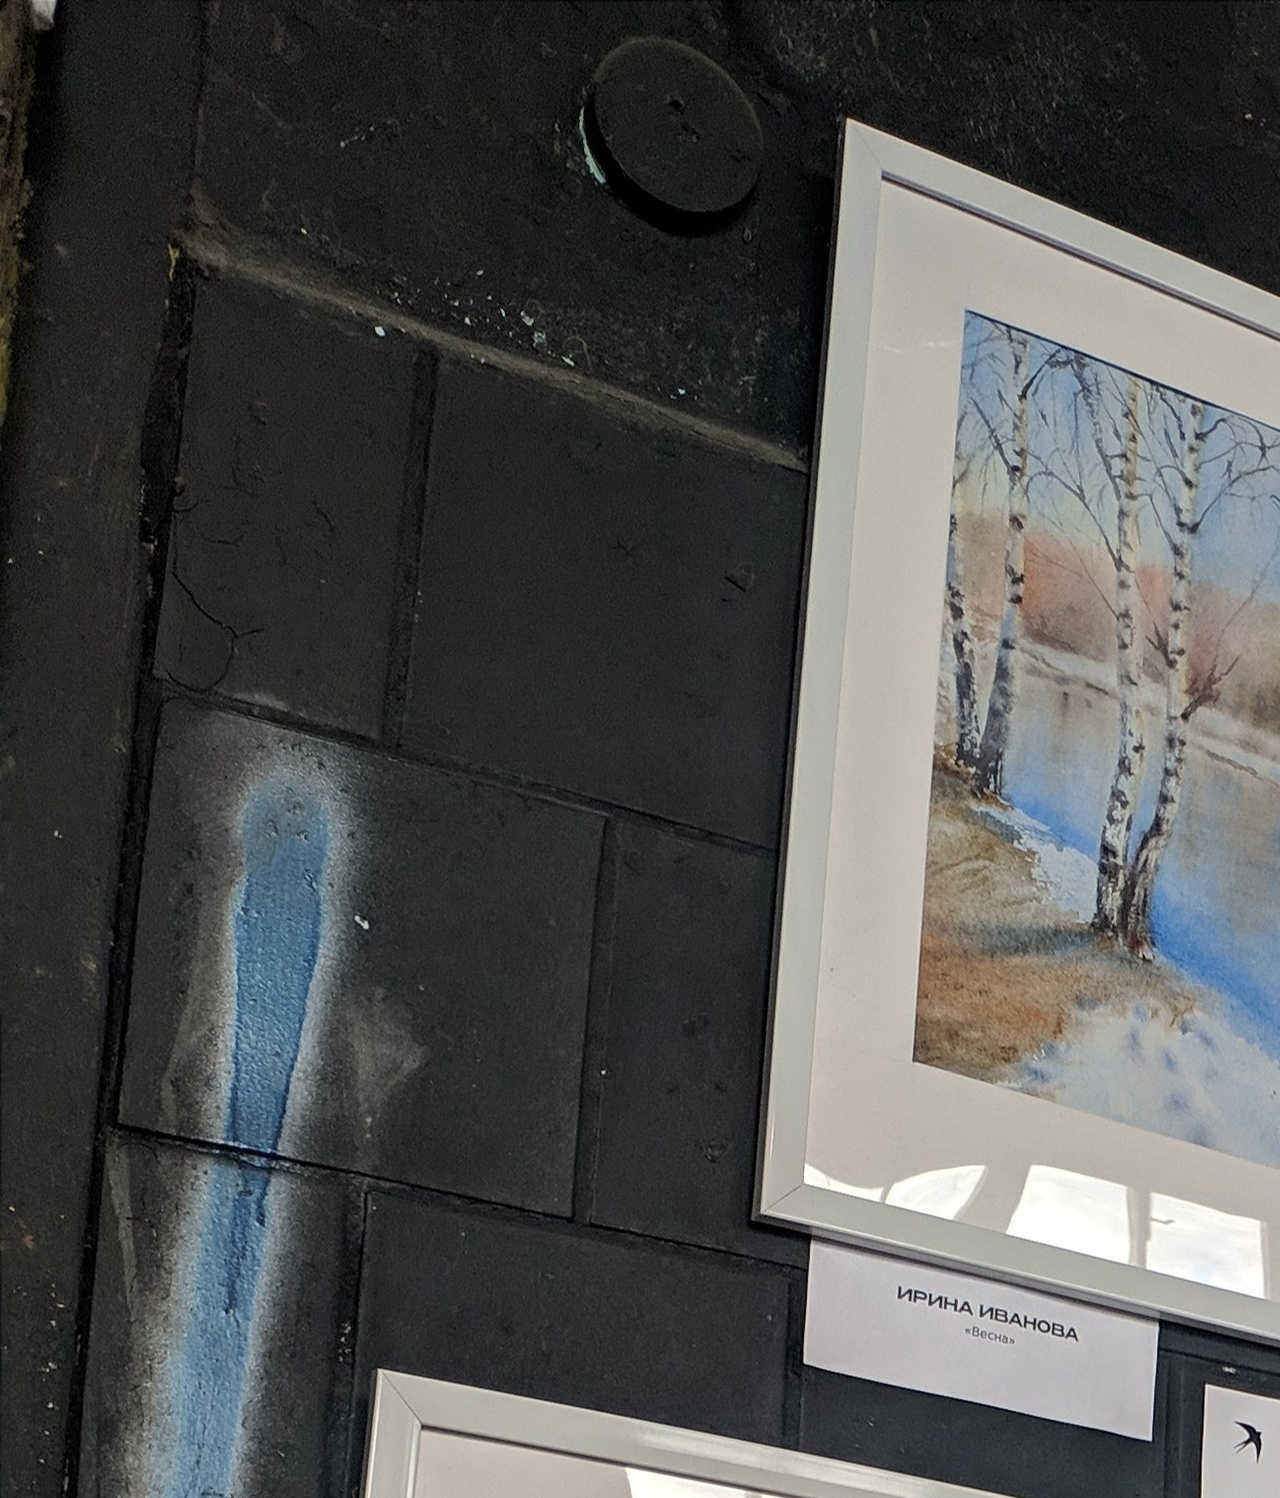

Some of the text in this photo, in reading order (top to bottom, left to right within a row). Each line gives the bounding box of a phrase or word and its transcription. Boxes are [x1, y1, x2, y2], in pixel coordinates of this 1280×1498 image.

[897, 1285, 1080, 1342] ИРИНА ИВАНОВА
[964, 1326, 1016, 1346] «Весна»
